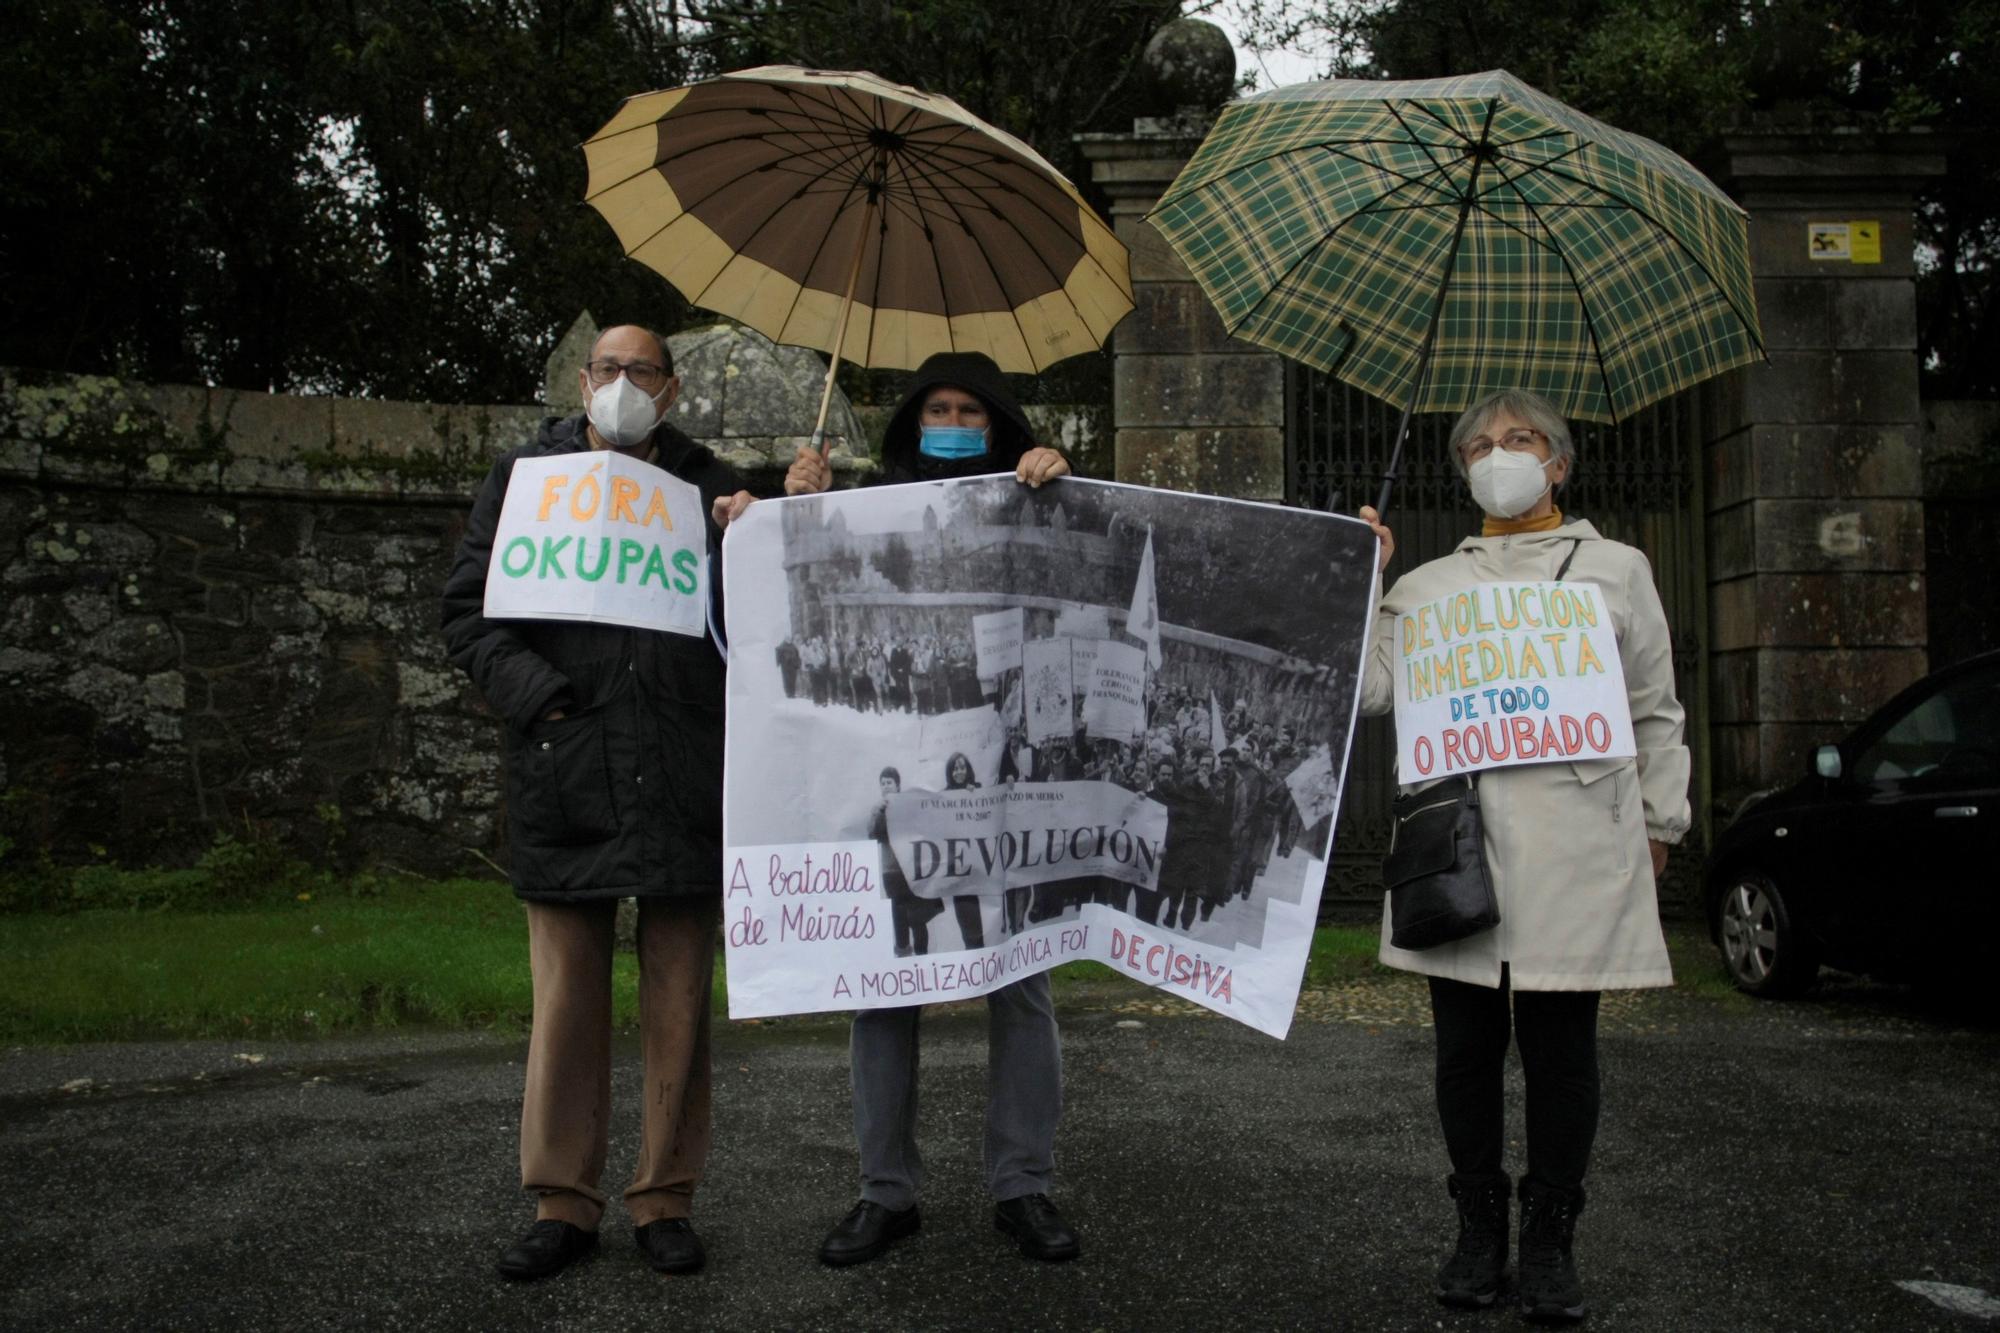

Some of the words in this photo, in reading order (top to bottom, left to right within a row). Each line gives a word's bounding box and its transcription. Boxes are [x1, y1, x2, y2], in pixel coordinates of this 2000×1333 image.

[536, 461, 673, 531] FÓRA
[500, 534, 699, 596] OKUPAS
[1402, 582, 1598, 657] DEVOLUCIÓN
[1405, 632, 1606, 702] INMEDIATA
[1449, 694, 1479, 722] DE
[1482, 685, 1550, 715] TODO
[1414, 735, 1434, 775] O
[1442, 711, 1612, 771] ROUBADO
[727, 857, 753, 899] A
[768, 851, 875, 897] batalla
[911, 820, 1160, 882] DEVOLUCIÓN
[730, 905, 768, 948] de
[780, 903, 875, 943] Meirás
[832, 974, 853, 999] A
[861, 951, 1005, 998] MOBILIZACIÓN
[1008, 936, 1052, 973] CÍVICA
[1060, 925, 1089, 954] FOI
[1109, 927, 1233, 1005] DECISIVA
